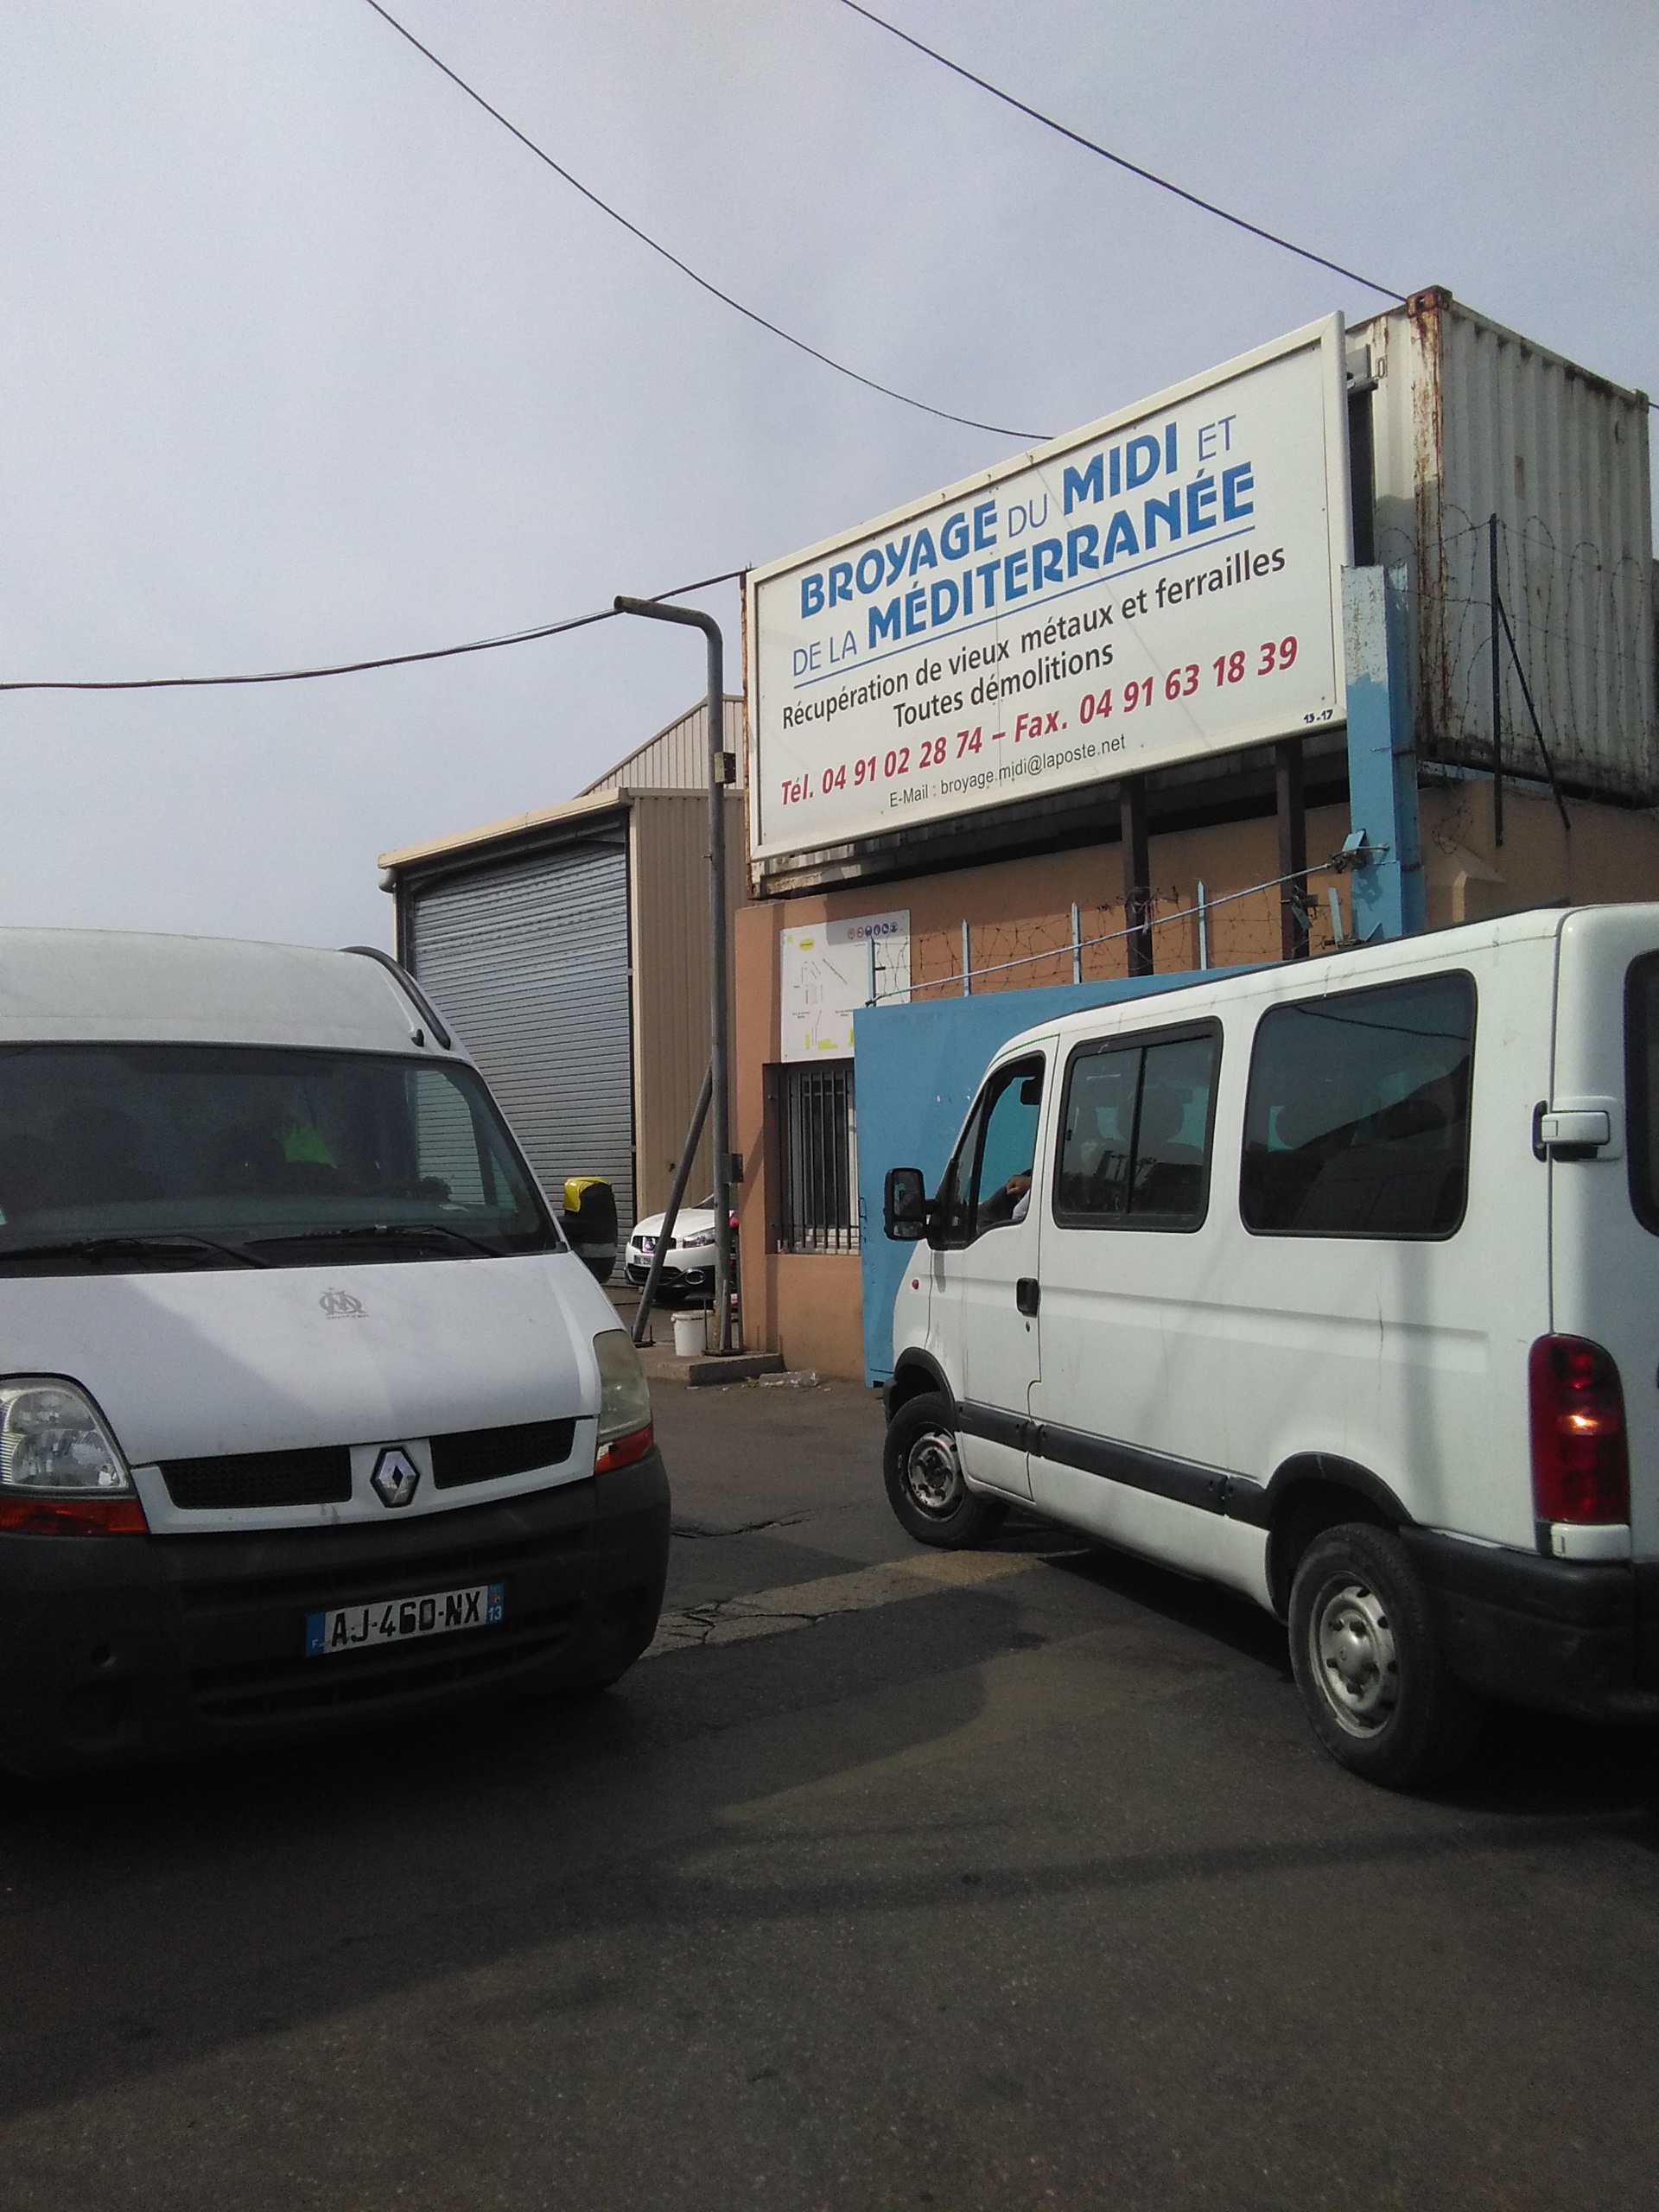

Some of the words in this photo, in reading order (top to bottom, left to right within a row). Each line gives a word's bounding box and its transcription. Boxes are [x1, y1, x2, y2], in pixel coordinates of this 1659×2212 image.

[793, 641, 822, 677] DE
[830, 630, 857, 664] LA
[868, 461, 1255, 650] MÉDITERRANÉE
[801, 499, 998, 620] BROYAGE
[1008, 493, 1048, 538] DU
[1063, 422, 1178, 517] MIDI
[1198, 414, 1236, 462] ET
[781, 774, 814, 805] Tél.
[822, 765, 847, 794] 04
[854, 756, 877, 786] 91
[884, 747, 910, 778] 02
[918, 737, 947, 769] 28
[957, 727, 982, 759] 74
[1014, 710, 1068, 742] Fax.
[1079, 689, 1113, 725] 04
[1123, 677, 1154, 713] 91
[1164, 664, 1200, 701] 63
[1212, 651, 1246, 688] 18
[1257, 635, 1298, 676] 39
[783, 674, 909, 730] Récupération
[915, 658, 942, 687] de
[948, 639, 1010, 676] vieux
[1020, 603, 1114, 653] métaux
[1122, 589, 1147, 620] et
[1155, 547, 1286, 609] ferrailles
[893, 690, 963, 728] Toutes
[970, 643, 1114, 706] démolitions
[889, 785, 928, 808] E-Mail
[940, 733, 1126, 797] broyage.midi@laposte.net
[487, 1605, 502, 1621] 13
